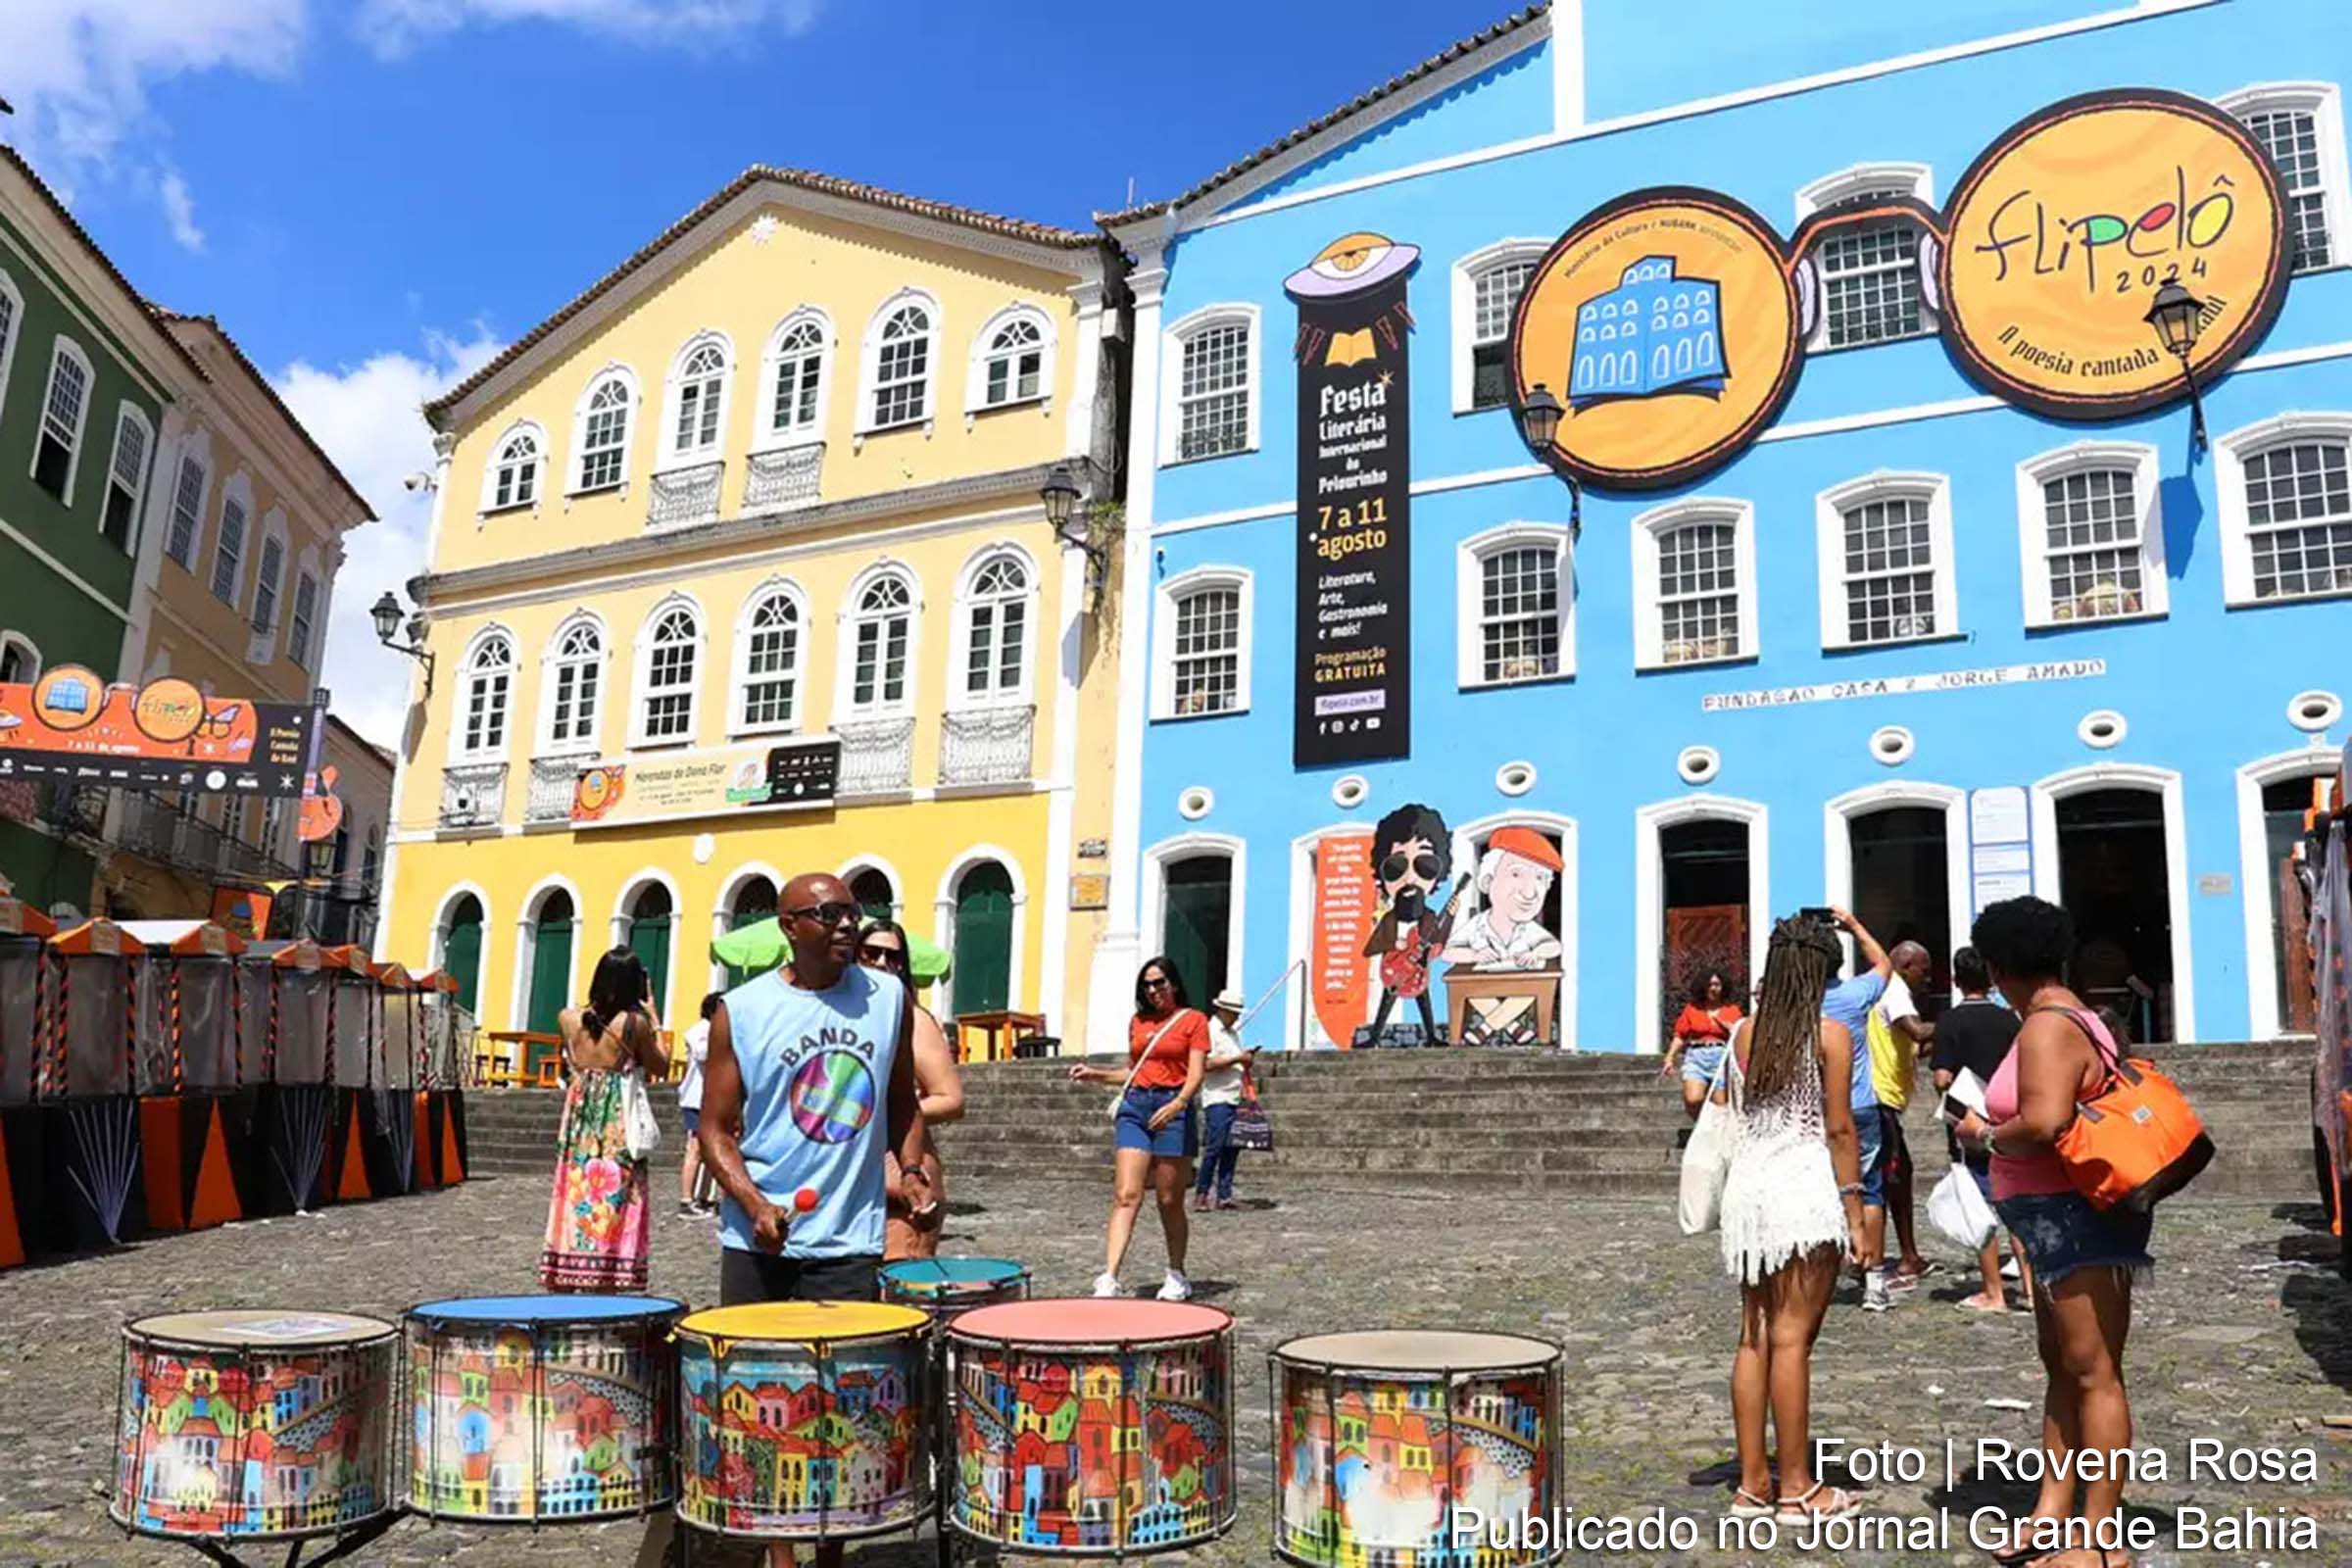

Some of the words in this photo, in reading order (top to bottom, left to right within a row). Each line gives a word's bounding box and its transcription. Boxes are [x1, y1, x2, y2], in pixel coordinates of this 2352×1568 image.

[2116, 256, 2208, 293] 2024
[2010, 338, 2075, 375] poesia
[2080, 347, 2160, 378] cantada
[1318, 379, 1387, 418] Festa
[1319, 412, 1387, 441] Literária
[1318, 468, 1388, 493] Pelourinho
[1317, 505, 1333, 530] 7
[1338, 508, 1352, 527] a
[1357, 497, 1388, 524] 11
[1317, 528, 1388, 562] agosto
[1318, 592, 1346, 606] Arte,
[1318, 601, 1388, 623] Gastronomia
[1317, 628, 1327, 640] e
[1314, 646, 1387, 666] Programação
[1314, 662, 1386, 683] GRATUITA
[2026, 660, 2103, 680] AMADO
[780, 1026, 876, 1068] BANDA
